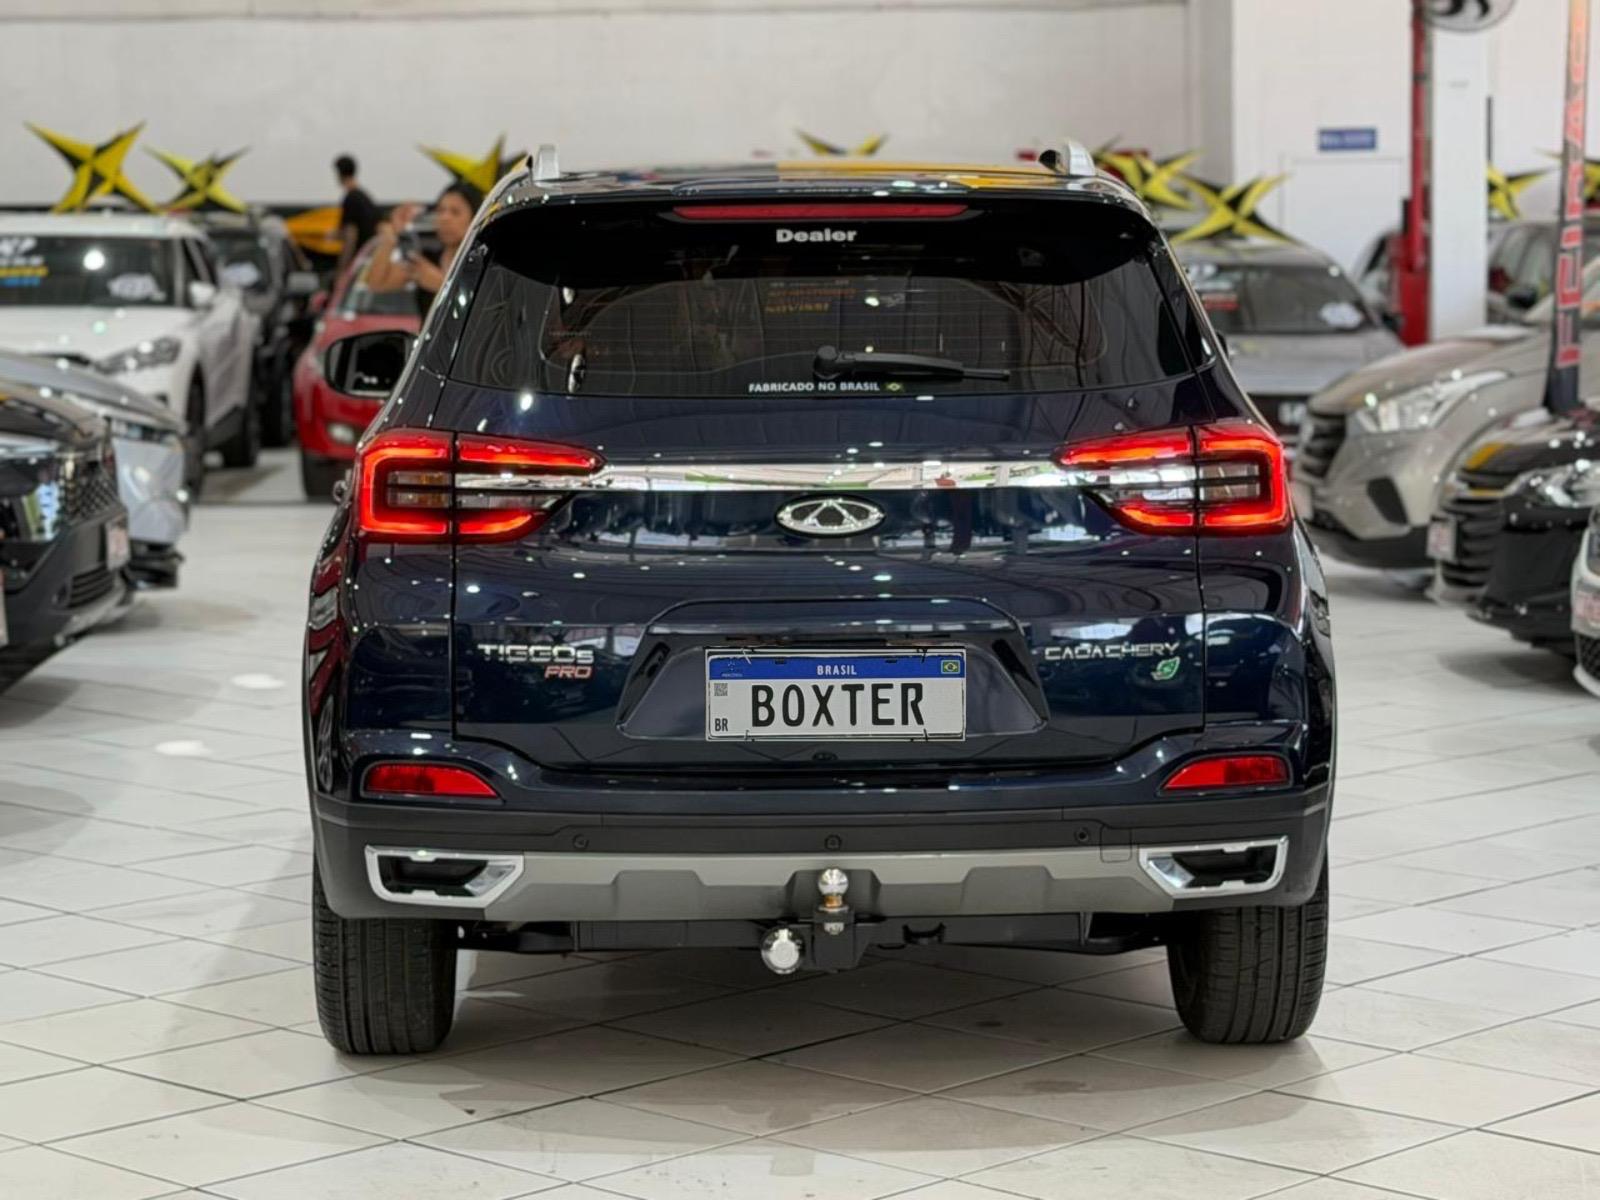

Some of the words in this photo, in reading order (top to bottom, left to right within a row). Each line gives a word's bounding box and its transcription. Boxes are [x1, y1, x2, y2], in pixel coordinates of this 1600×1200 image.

[776, 228, 857, 243] Dealer
[748, 382, 815, 392] FABRICADO
[818, 382, 836, 391] NO
[839, 381, 880, 391] BRASIL
[544, 665, 593, 679] PRO
[816, 664, 857, 676] BRASIL
[751, 683, 925, 727] BOXTER
[714, 718, 728, 732] BR
